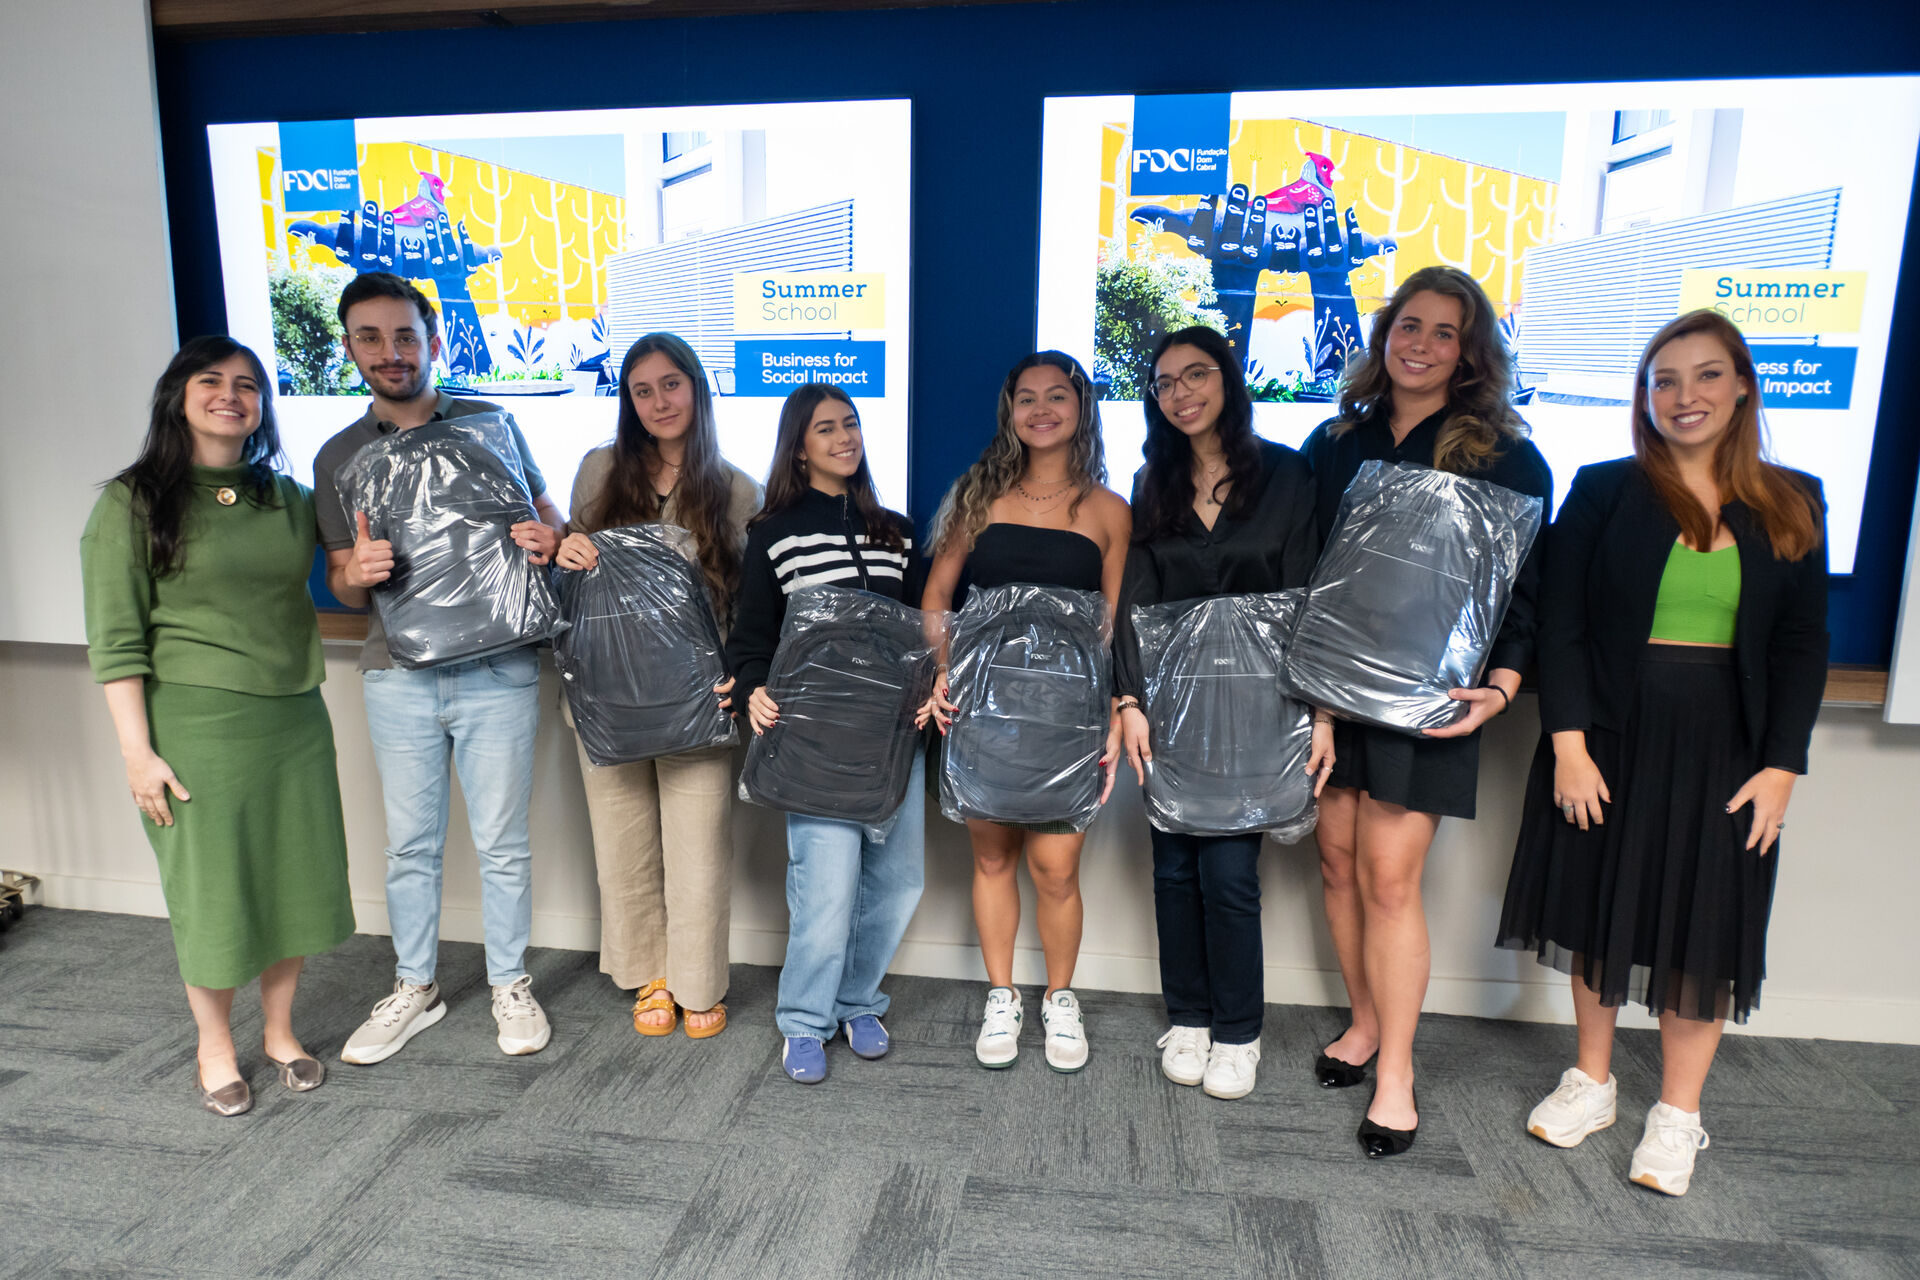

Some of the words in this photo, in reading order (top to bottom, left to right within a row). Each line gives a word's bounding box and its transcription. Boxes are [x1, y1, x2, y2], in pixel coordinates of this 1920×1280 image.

[1132, 148, 1190, 173] FDC
[1196, 148, 1228, 157] Fundação
[1195, 163, 1217, 171] Cabral
[283, 168, 329, 191] FDC
[762, 279, 867, 299] Summer
[1715, 276, 1845, 298] Summer
[762, 301, 837, 321] School
[1714, 301, 1805, 323] School
[762, 352, 831, 367] Business
[834, 352, 857, 367] for
[1793, 359, 1822, 375] for
[762, 369, 808, 384] Social
[812, 369, 868, 386] Impact
[1764, 378, 1833, 398] Impact
